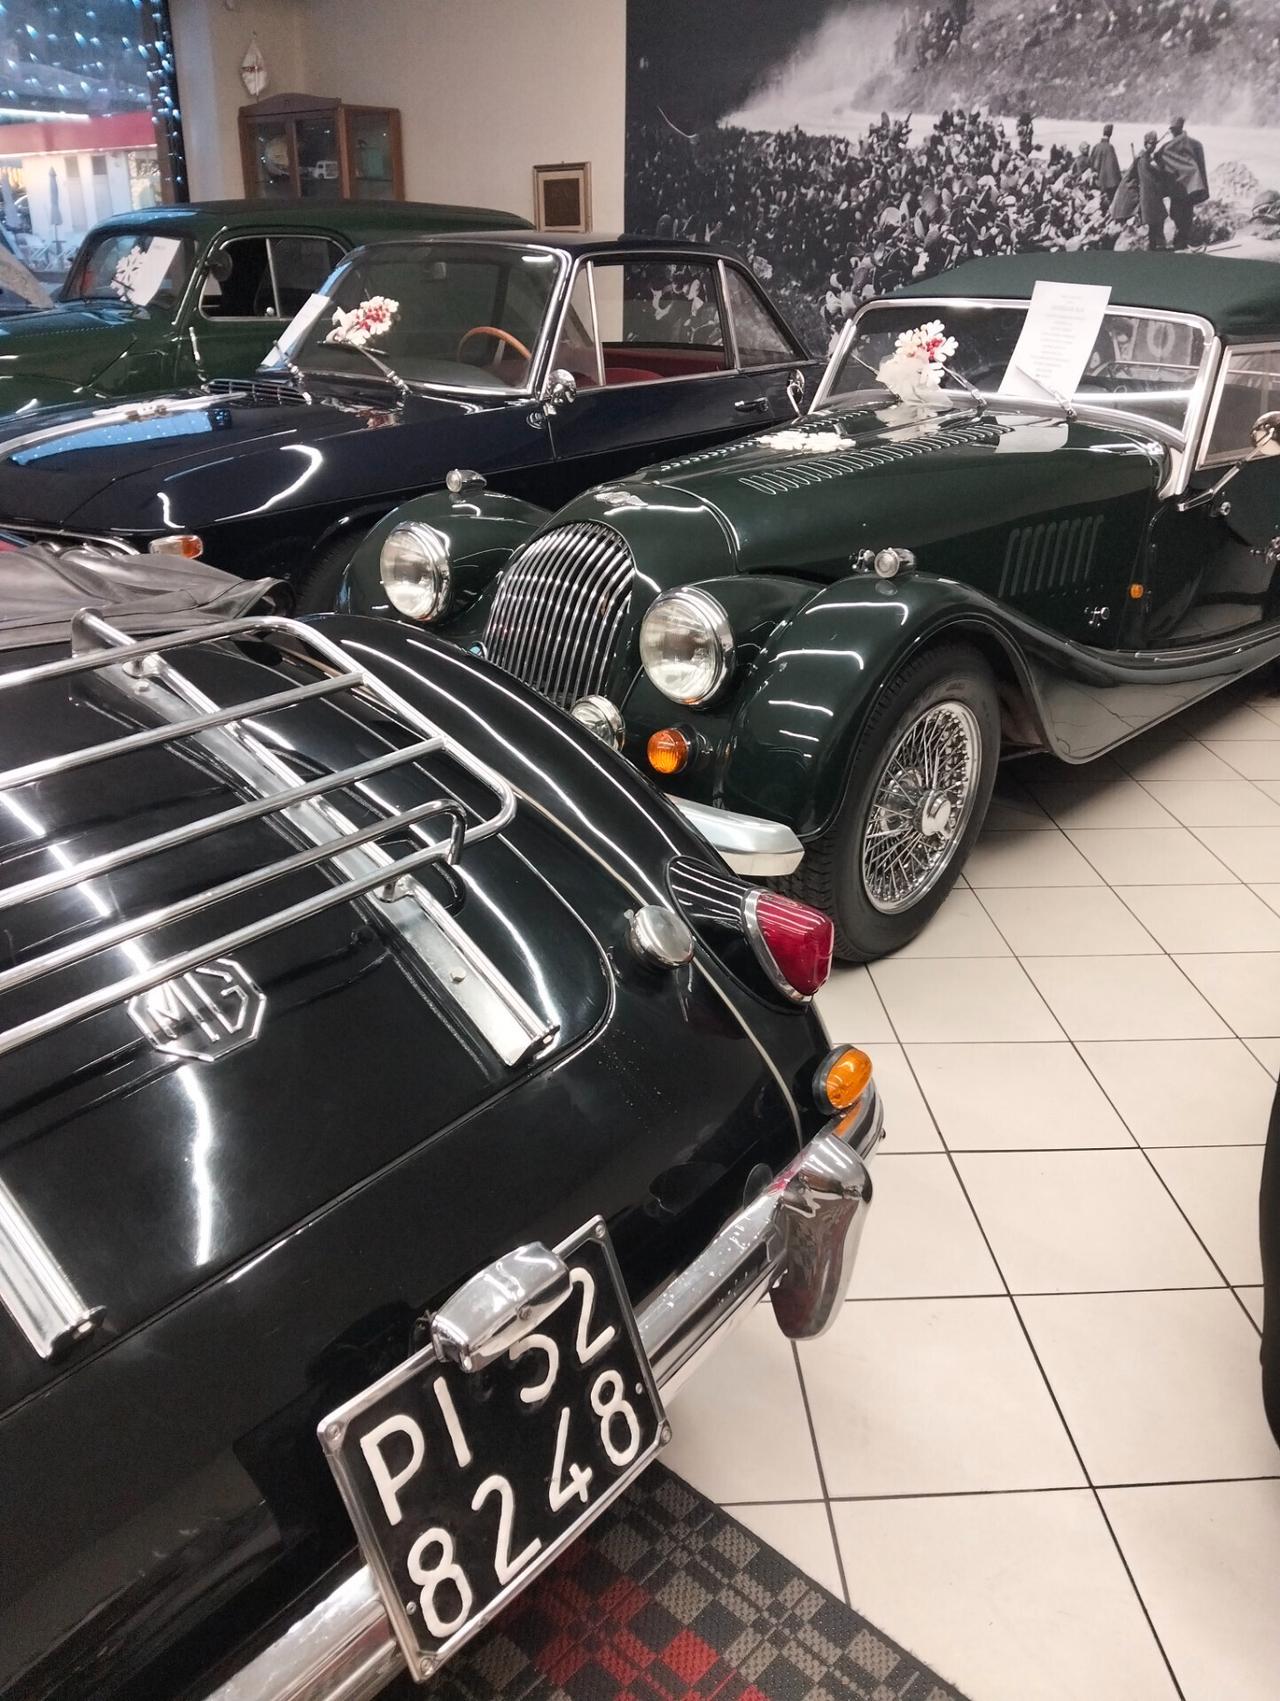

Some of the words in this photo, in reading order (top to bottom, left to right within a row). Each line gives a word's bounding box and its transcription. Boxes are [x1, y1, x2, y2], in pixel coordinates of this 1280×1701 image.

[143, 965, 250, 1043] MG
[361, 1376, 472, 1525] PI
[407, 1369, 640, 1637] 8248
